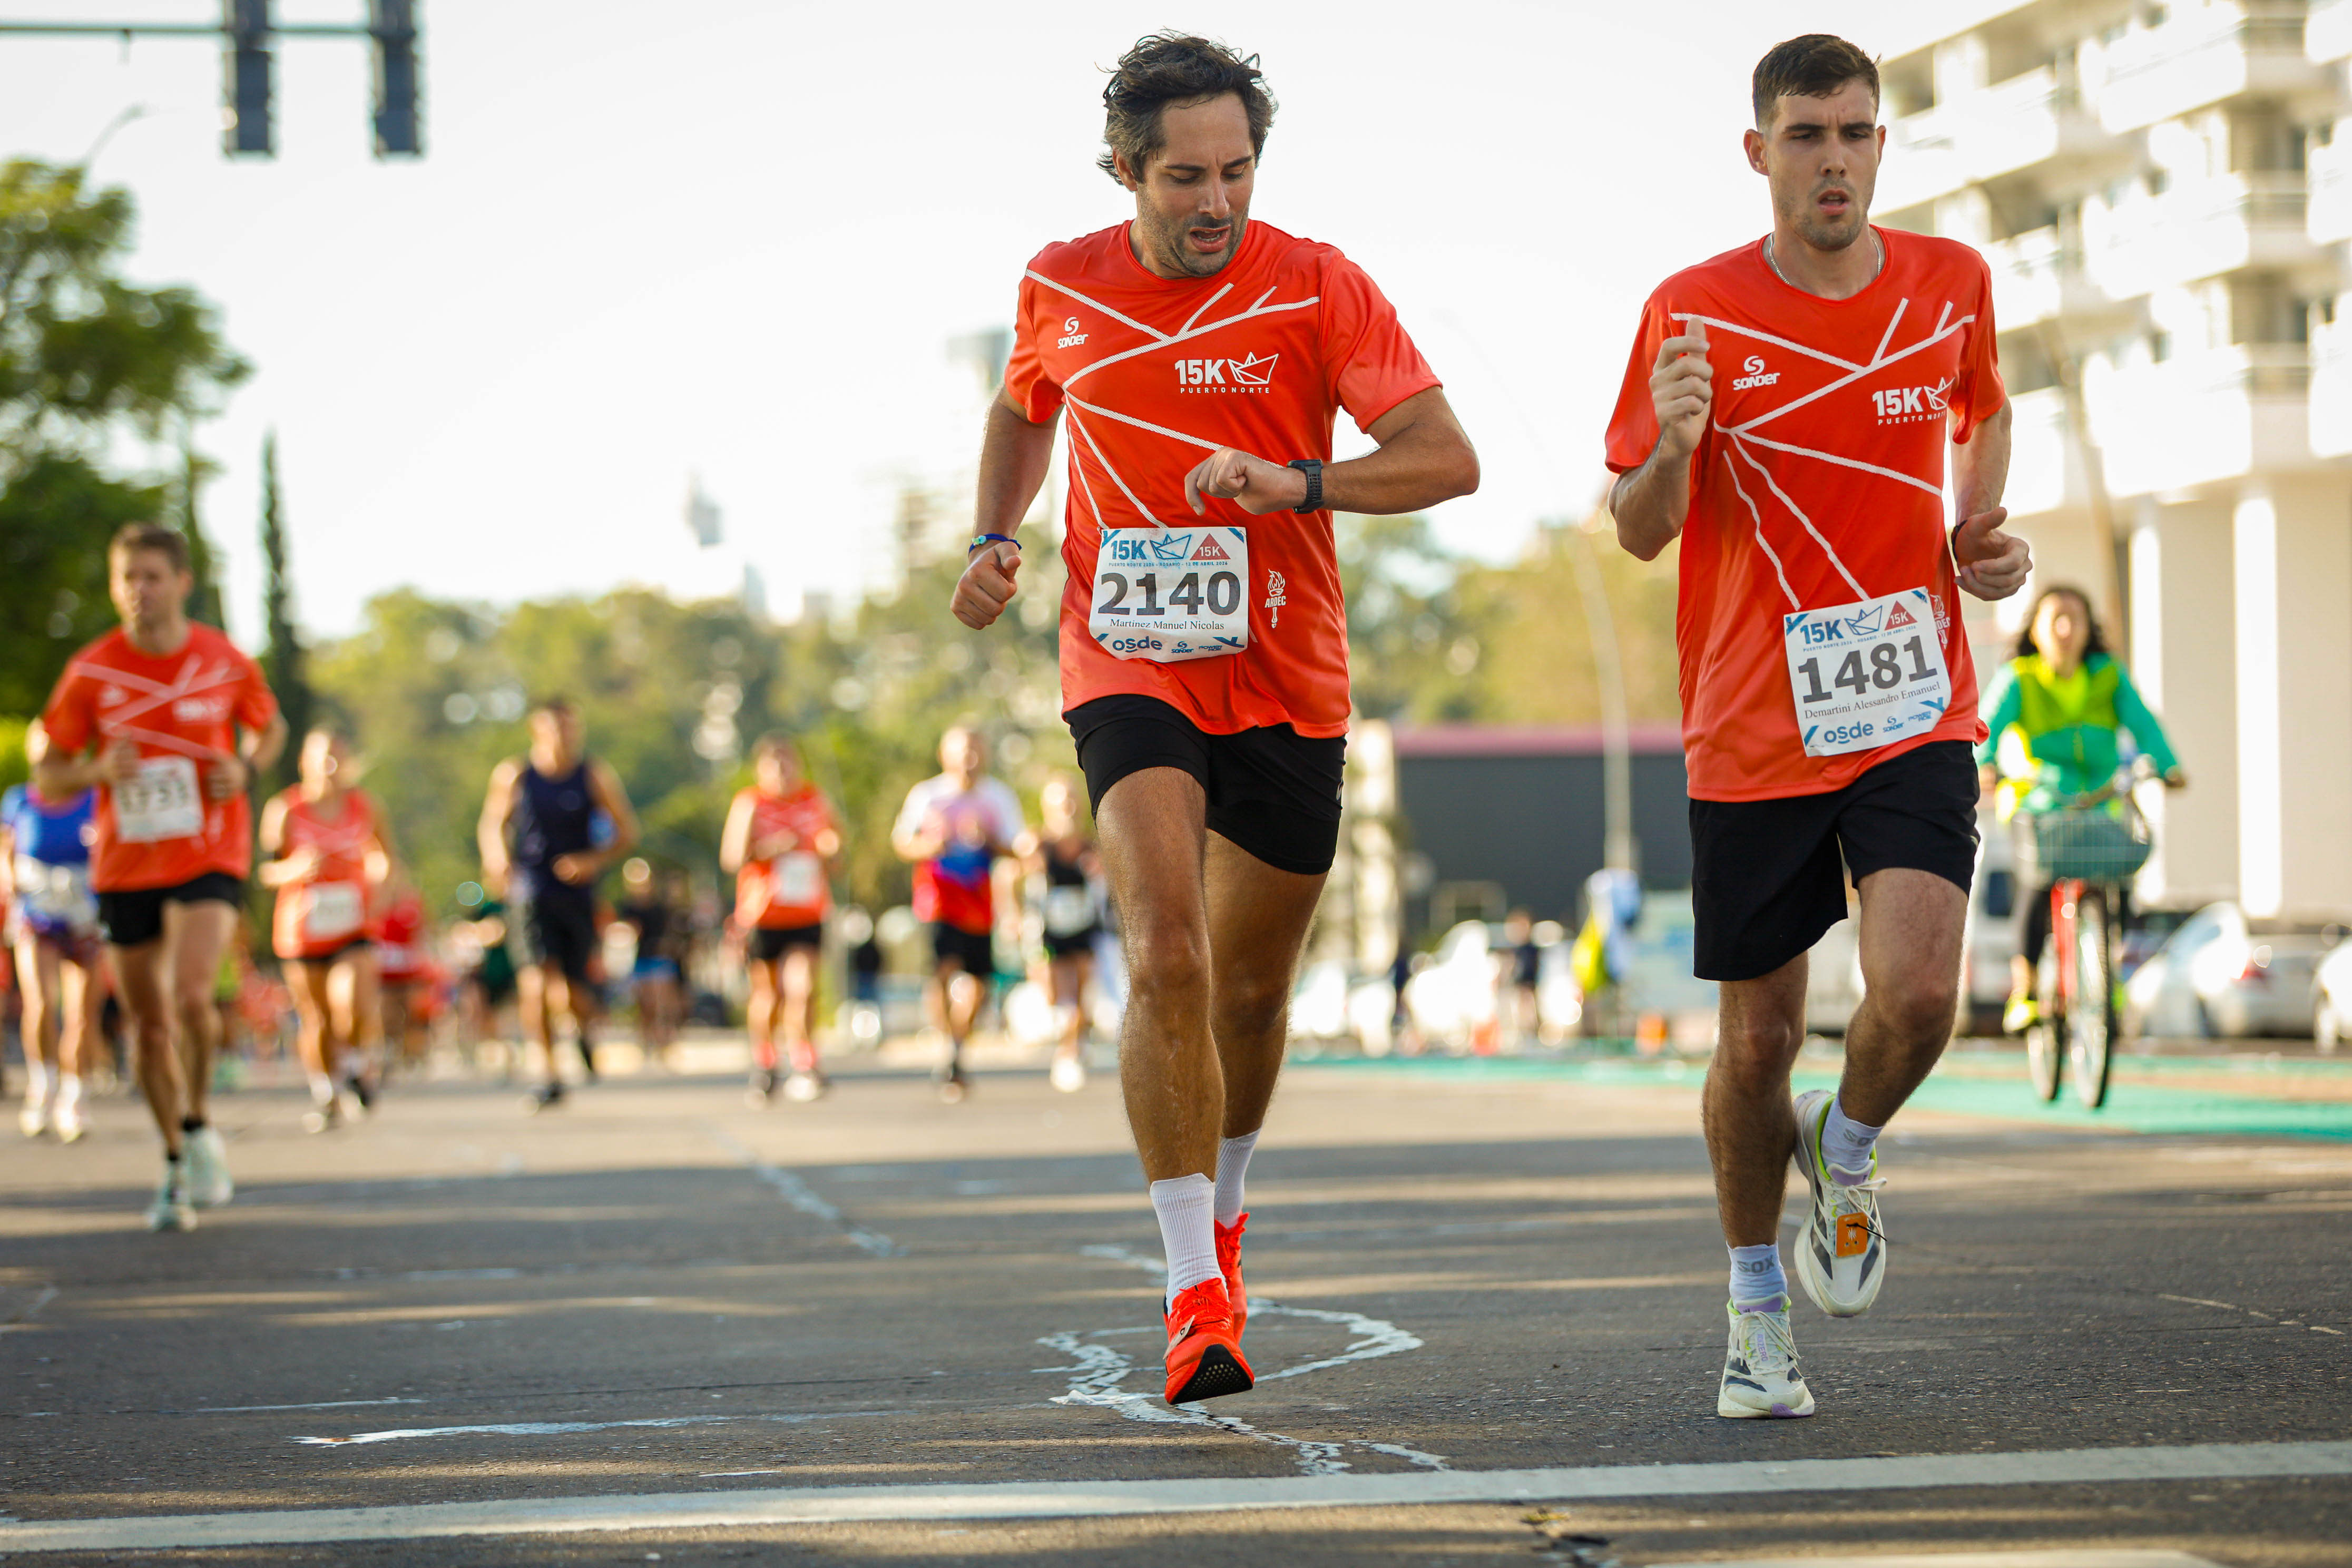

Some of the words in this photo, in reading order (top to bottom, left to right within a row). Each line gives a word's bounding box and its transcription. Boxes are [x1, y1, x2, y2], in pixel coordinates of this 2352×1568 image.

[1174, 359, 1226, 385] 15K
[1871, 387, 1924, 416] 15K
[1878, 415, 1923, 426] PUERTO
[1110, 540, 1147, 560] 15K
[1199, 546, 1221, 557] 15K
[1097, 571, 1240, 615] 2140
[1265, 596, 1286, 608] ARDEC
[1110, 619, 1151, 628] Martinez
[1153, 621, 1187, 629] Manuel
[1190, 621, 1224, 630] Nicolas
[1890, 611, 1908, 625] 15K
[1800, 619, 1844, 644] 15K
[1112, 636, 1162, 651] osde
[1798, 635, 1938, 704] 1481
[1805, 705, 1851, 719] Demartini
[1854, 693, 1899, 711] Alessandro
[1902, 682, 1941, 699] Emanuel
[1824, 721, 1874, 743] osde
